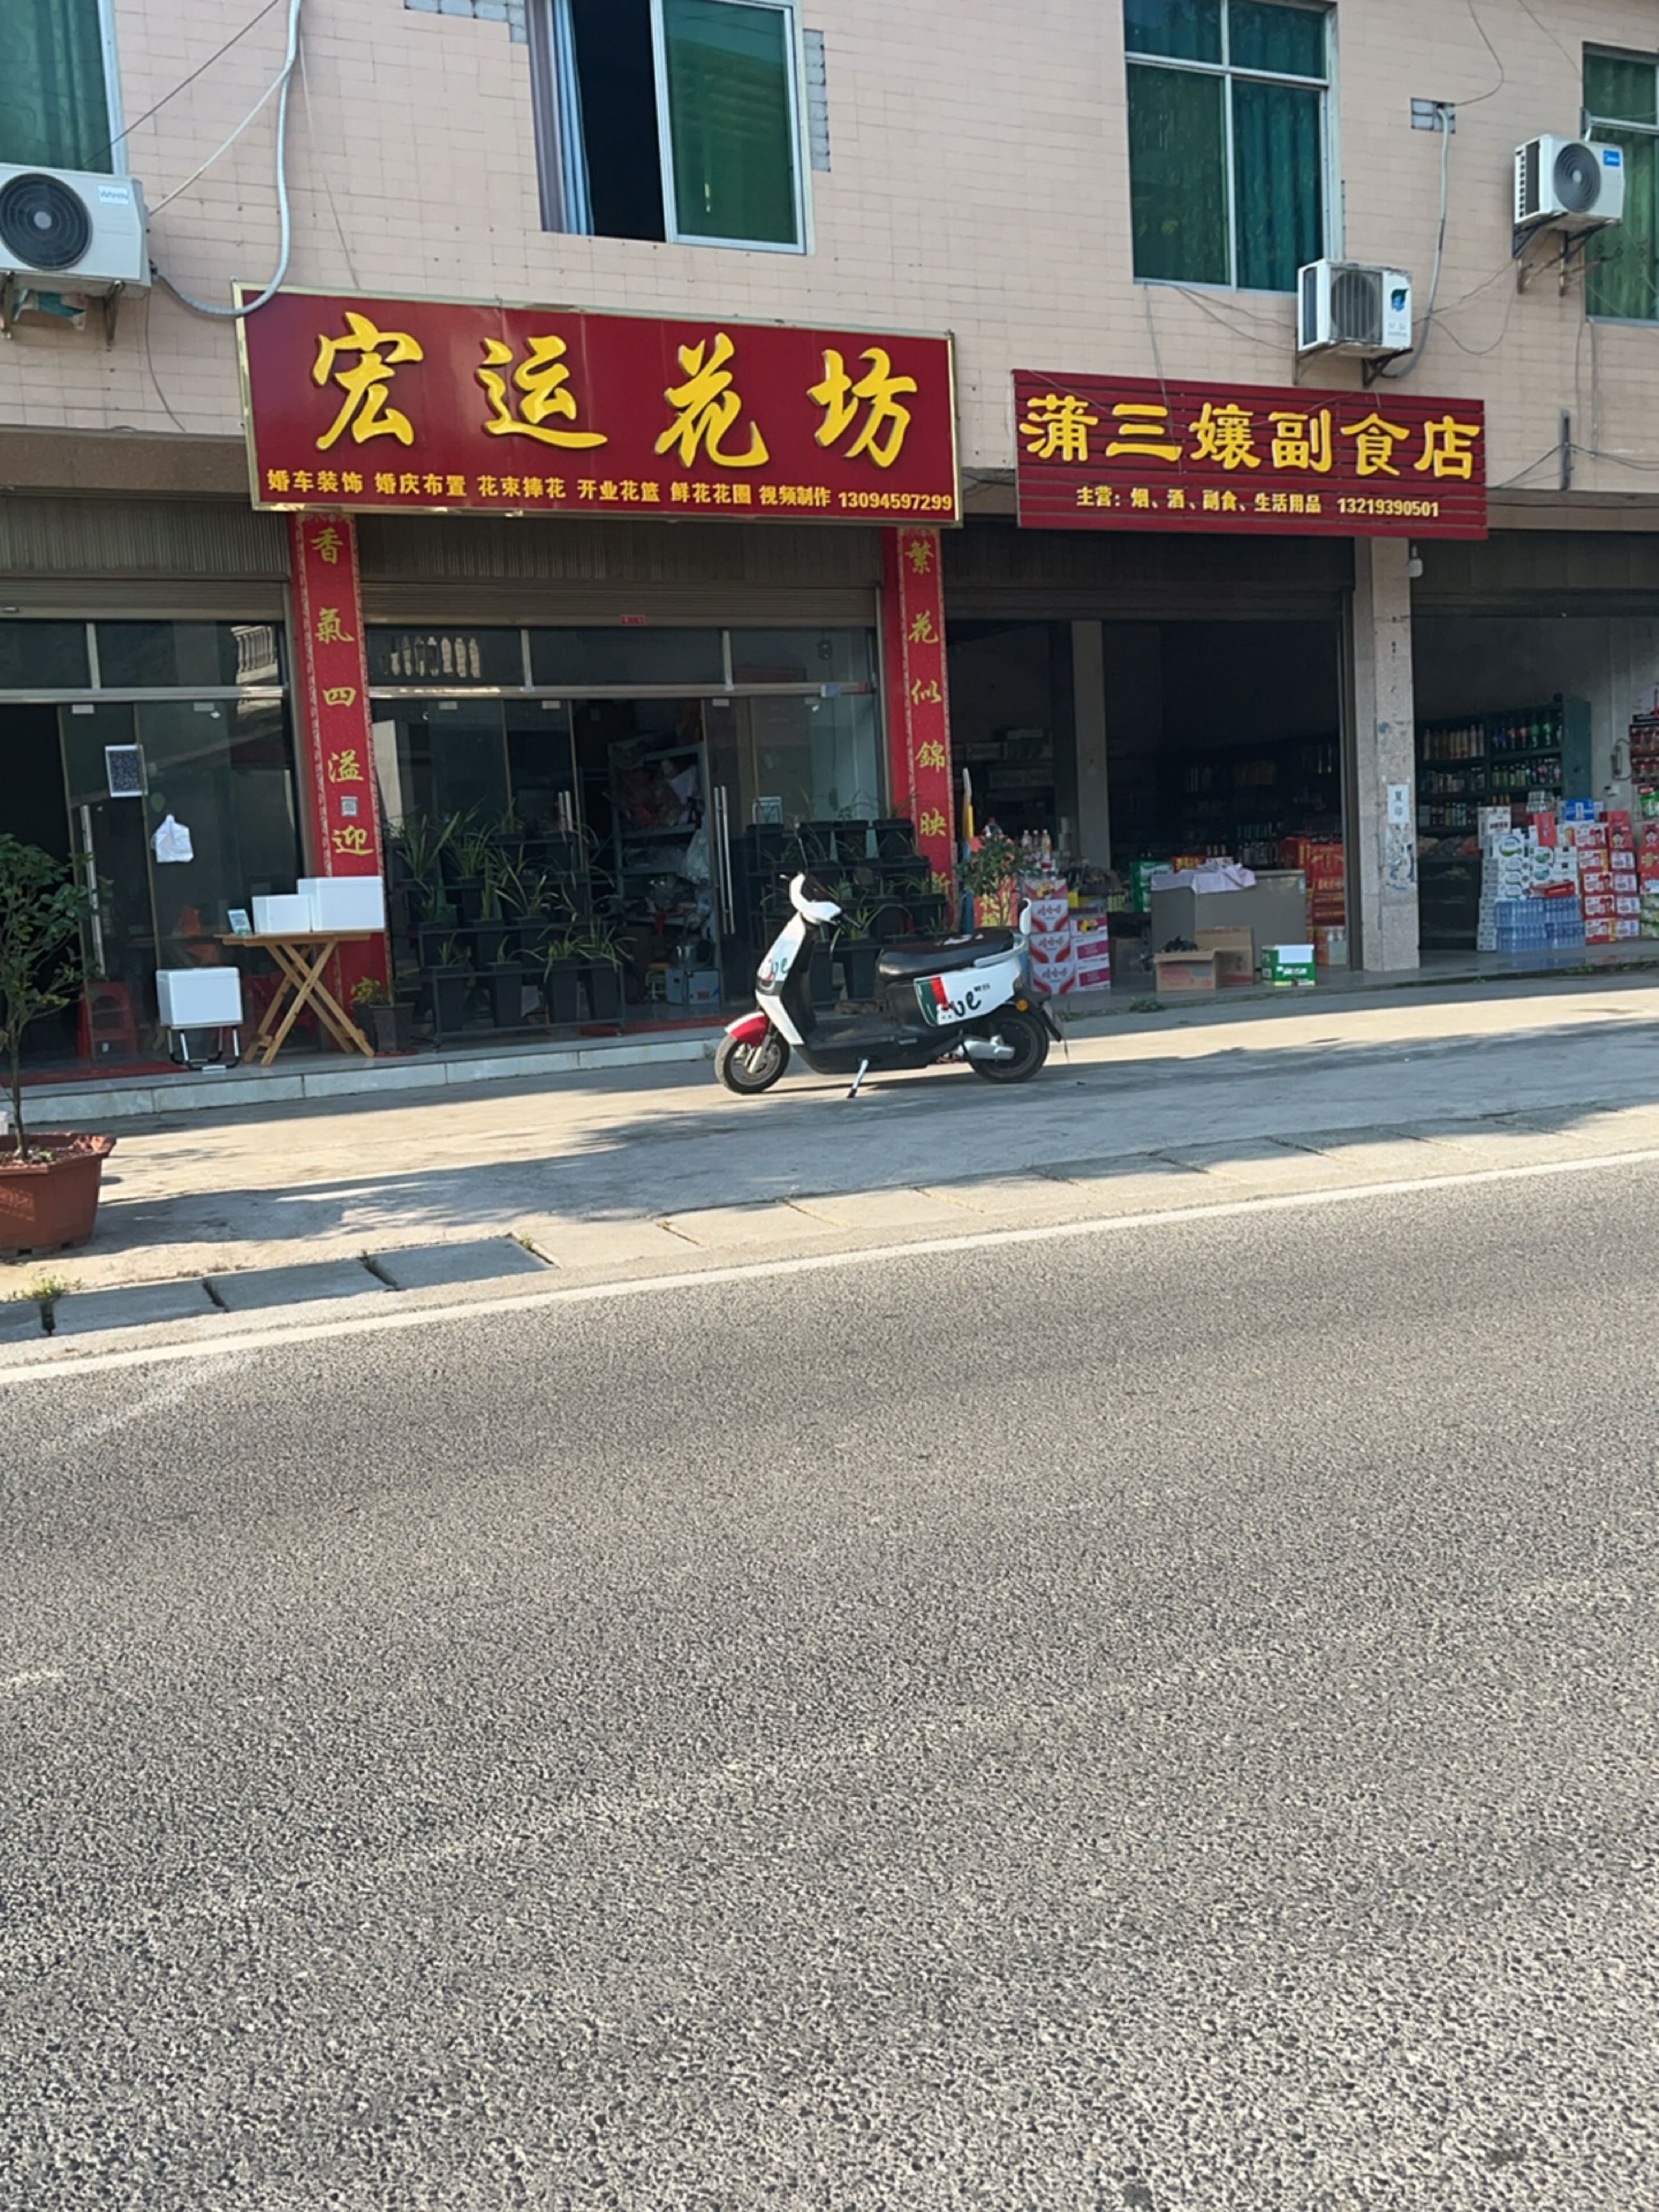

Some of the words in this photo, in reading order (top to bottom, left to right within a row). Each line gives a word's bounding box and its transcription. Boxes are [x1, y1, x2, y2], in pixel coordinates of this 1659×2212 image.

[311, 310, 918, 469] 宏运花坊
[267, 469, 364, 493] 婚车装饰
[375, 472, 467, 497] 婚庆布置
[577, 479, 661, 502] 开业花篮
[759, 485, 831, 507] 视频制作
[838, 491, 953, 511] 13094597299
[1336, 497, 1439, 517] 13219390501
